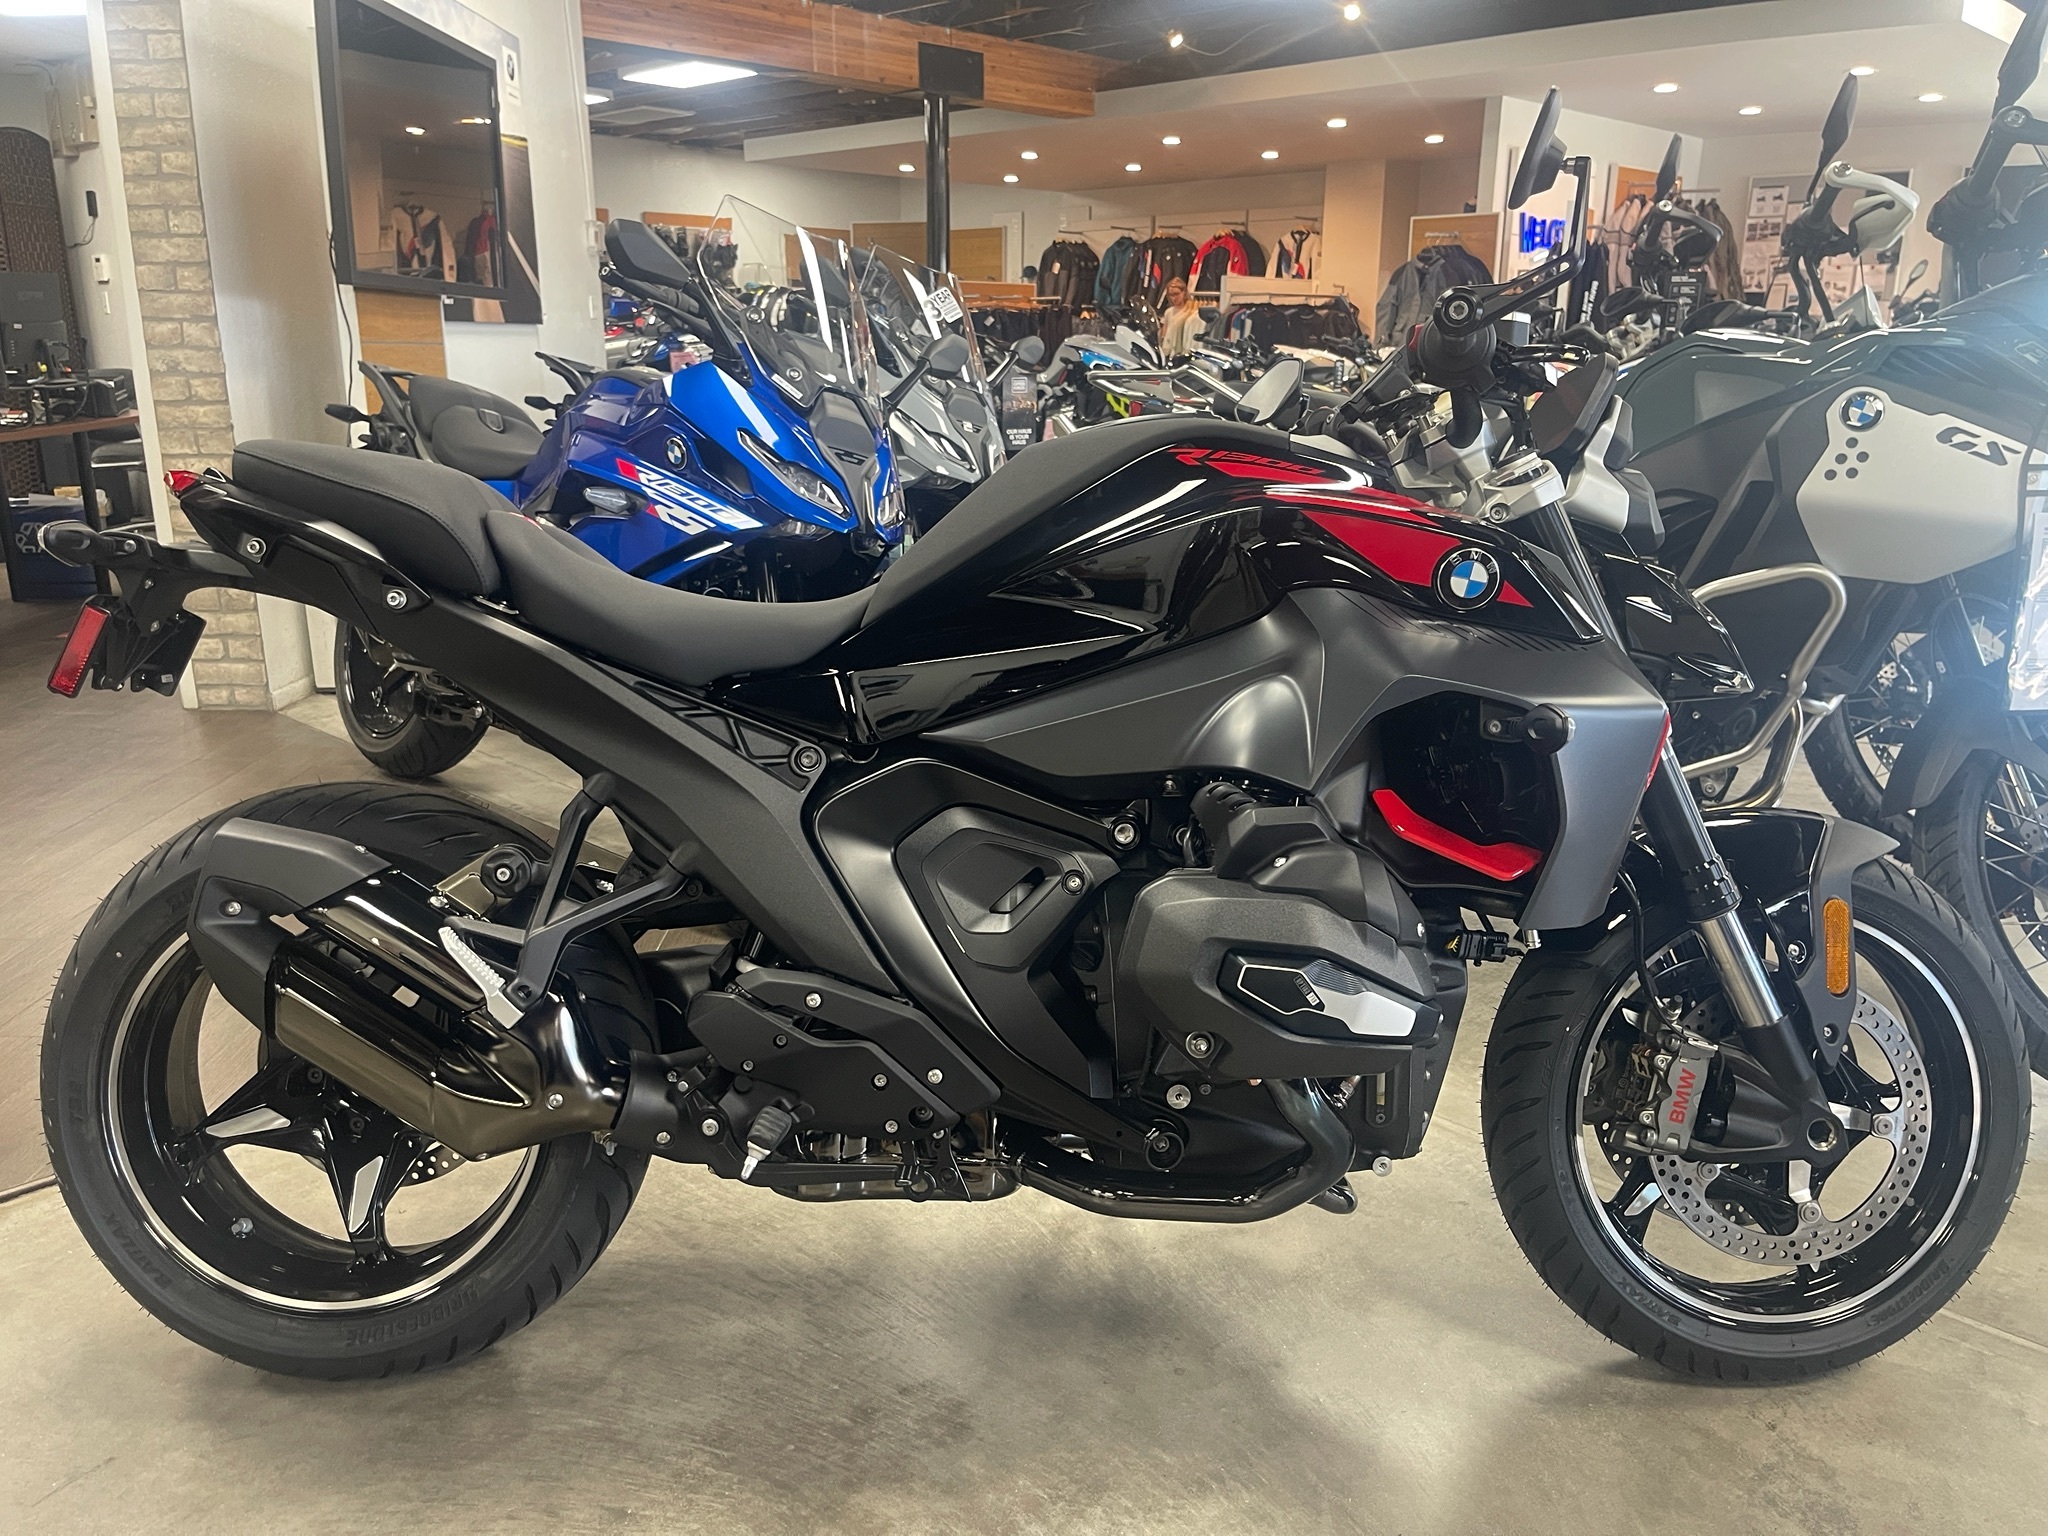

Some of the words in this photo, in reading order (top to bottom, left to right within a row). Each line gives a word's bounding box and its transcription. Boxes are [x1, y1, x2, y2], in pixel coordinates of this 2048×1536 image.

[930, 289, 953, 306] YEAR
[1936, 426, 2023, 466] GS
[1450, 549, 1498, 574] BMW
[1668, 1067, 1697, 1125] BMW
